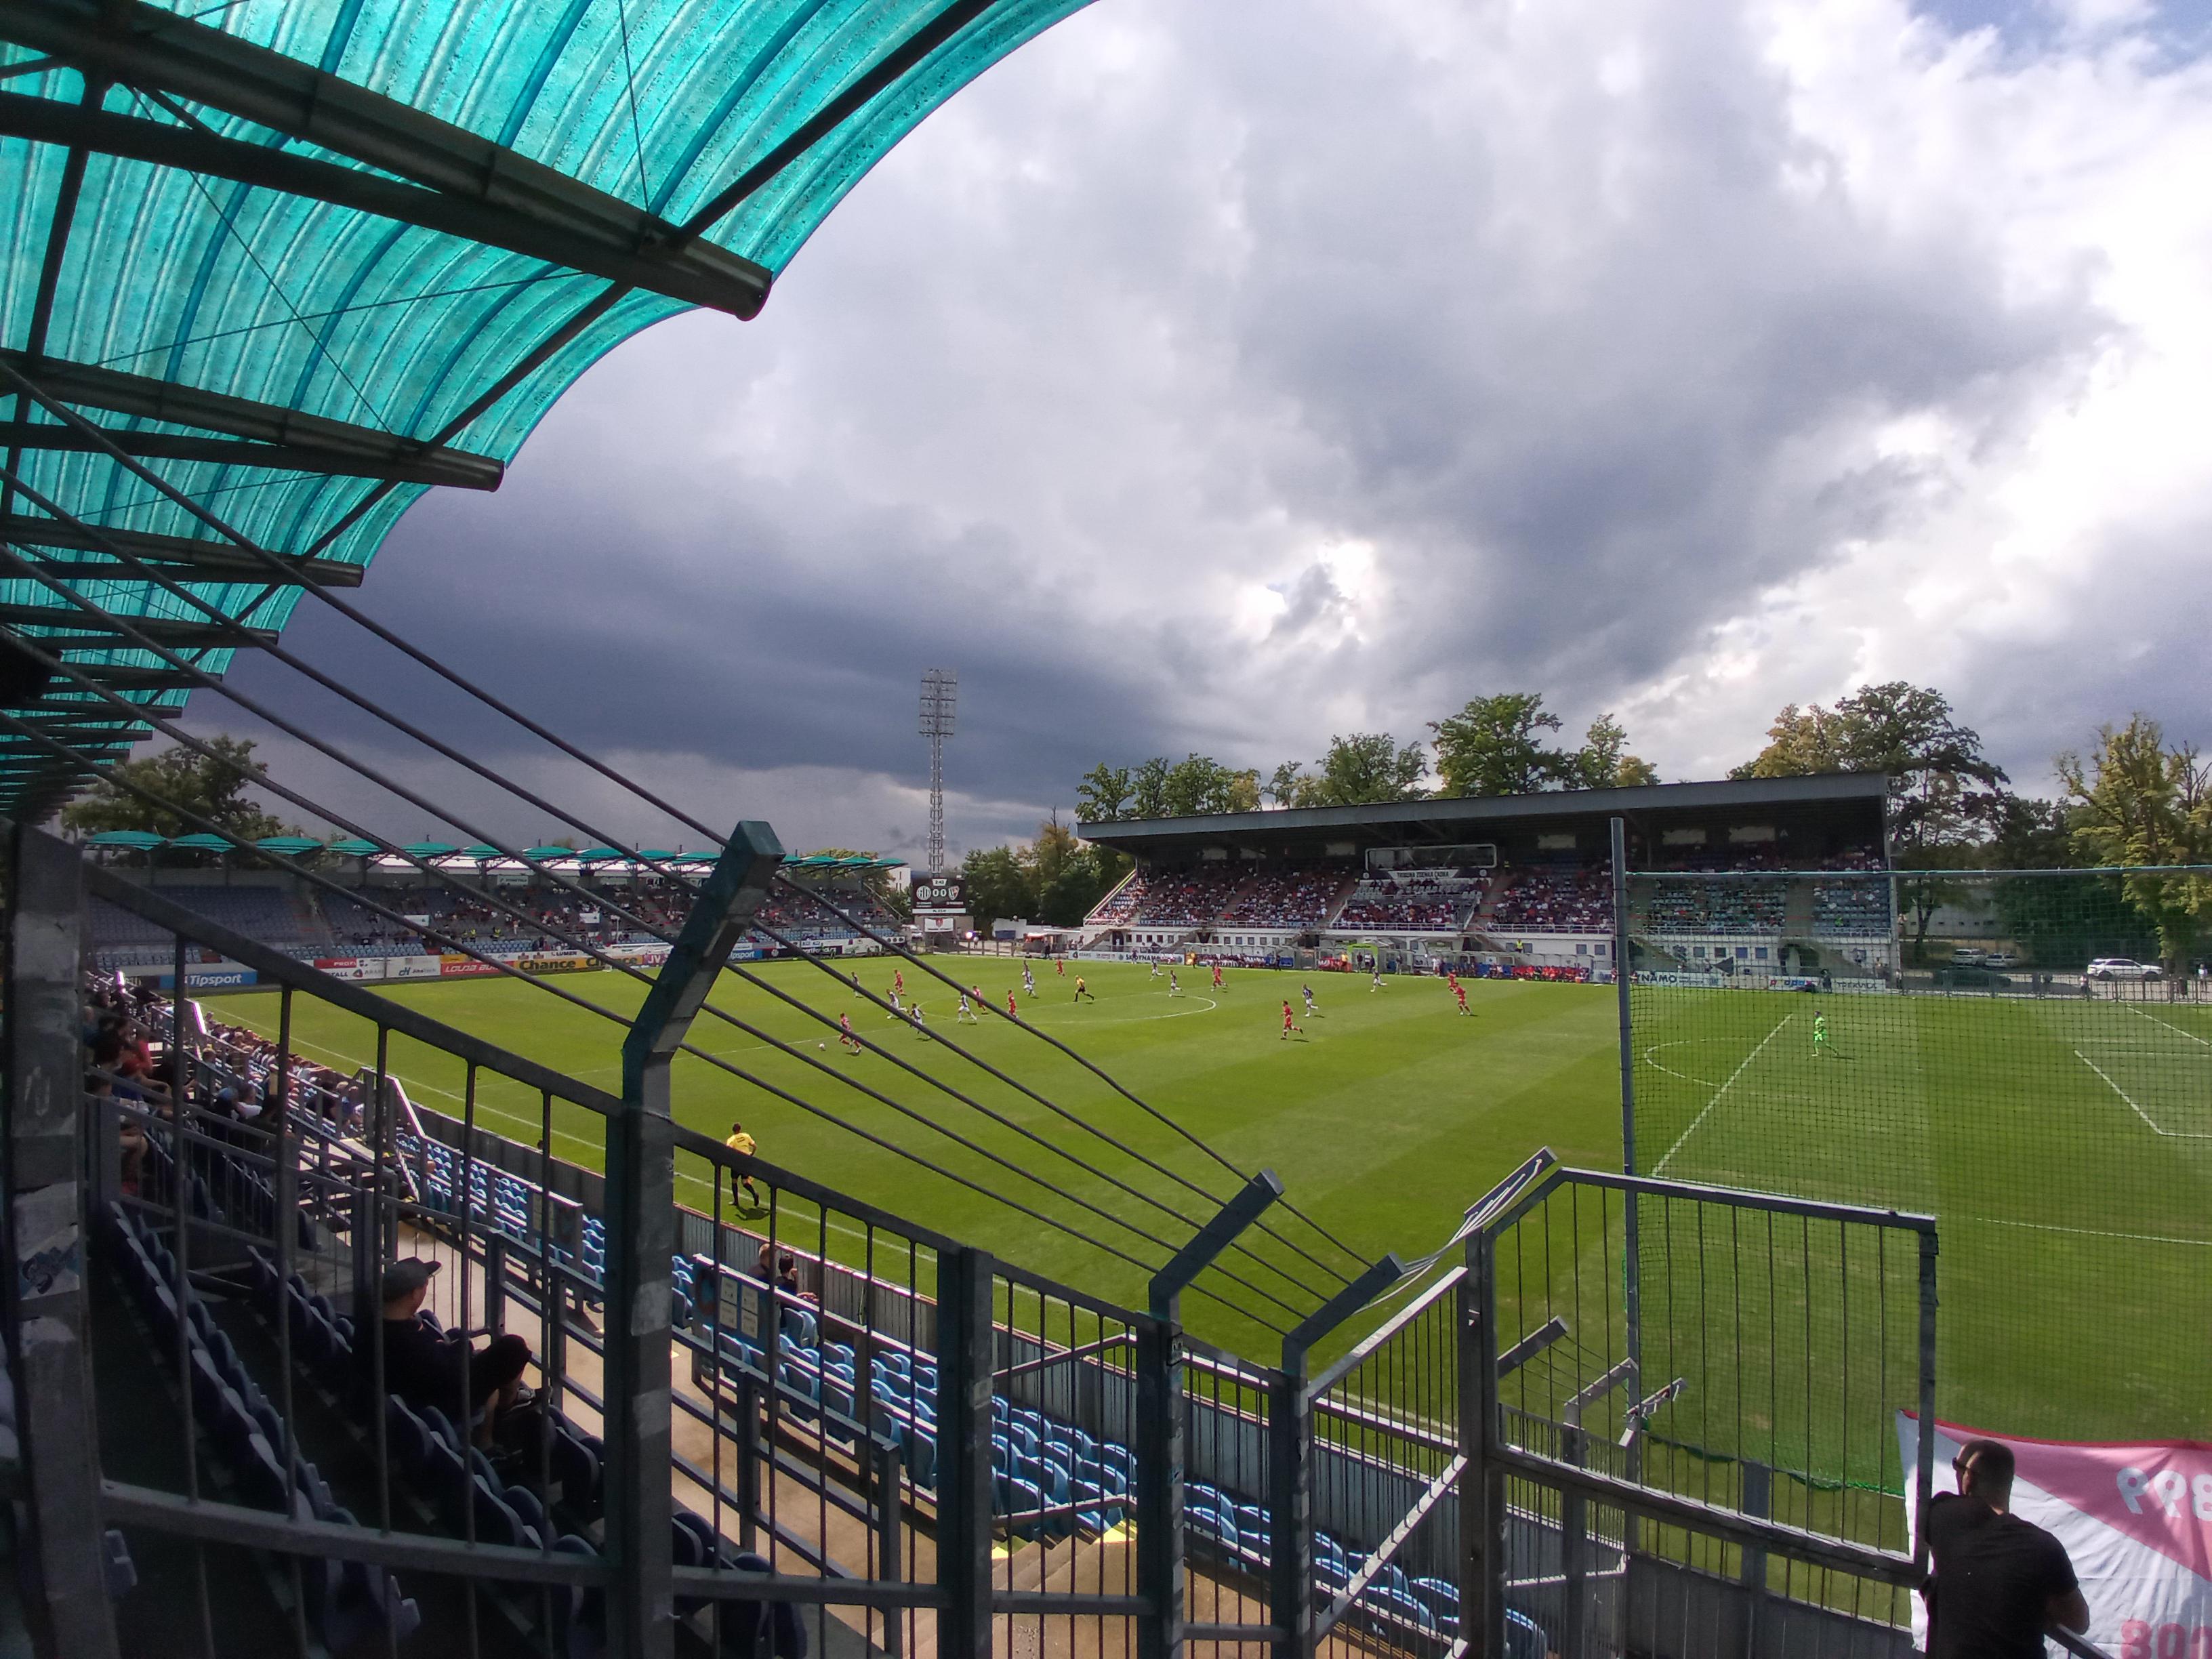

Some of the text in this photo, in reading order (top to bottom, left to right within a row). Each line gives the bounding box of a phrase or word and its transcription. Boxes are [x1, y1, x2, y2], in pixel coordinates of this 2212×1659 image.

[933, 888, 947, 897] 0 0
[519, 959, 576, 970] Chance
[189, 973, 242, 987] Tipsport
